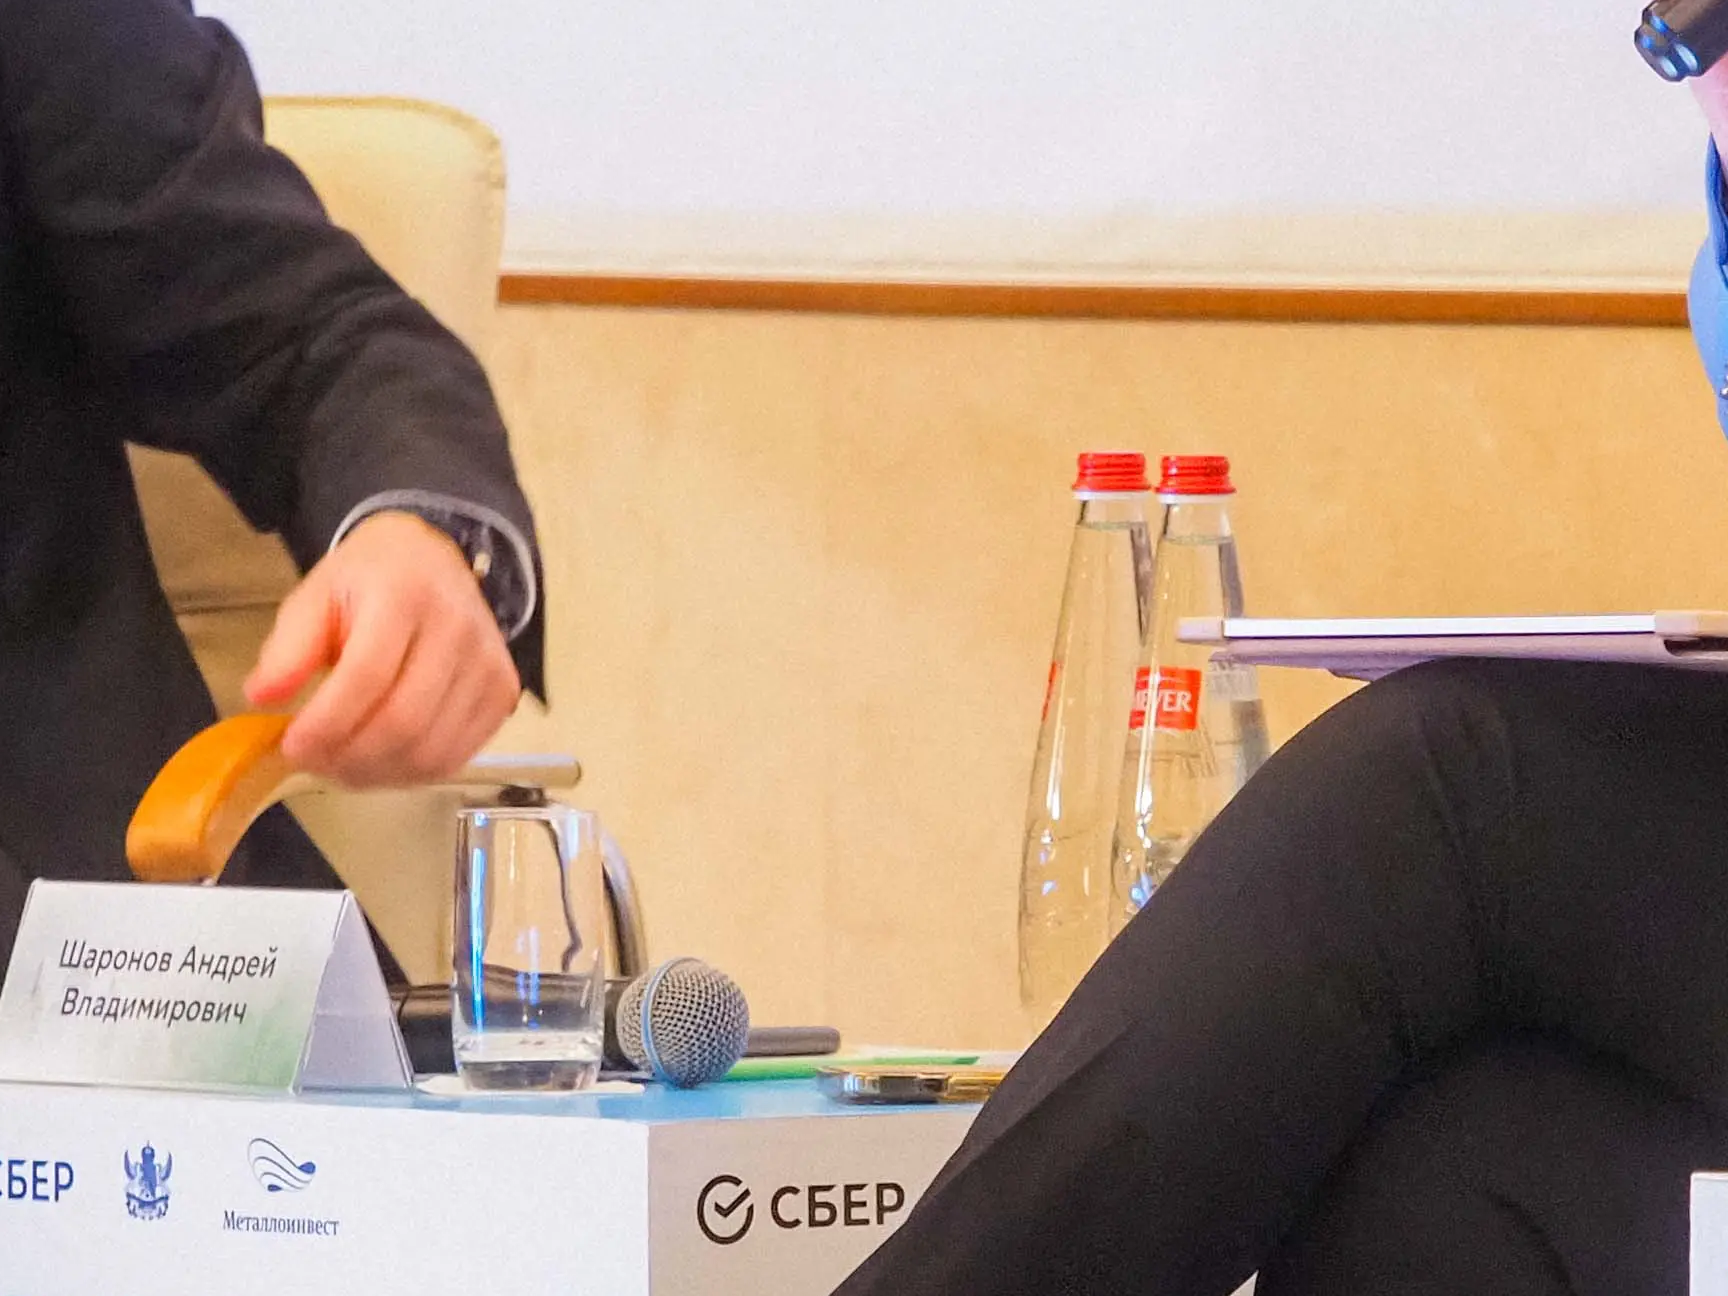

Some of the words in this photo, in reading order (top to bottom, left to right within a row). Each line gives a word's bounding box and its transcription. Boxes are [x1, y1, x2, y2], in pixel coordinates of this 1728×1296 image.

[58, 939, 173, 977] Шаронов
[178, 945, 278, 984] Андрей
[60, 986, 248, 1028] Владимирович
[223, 1209, 340, 1236] Металлоинвест
[769, 1181, 907, 1231] СБЕР
